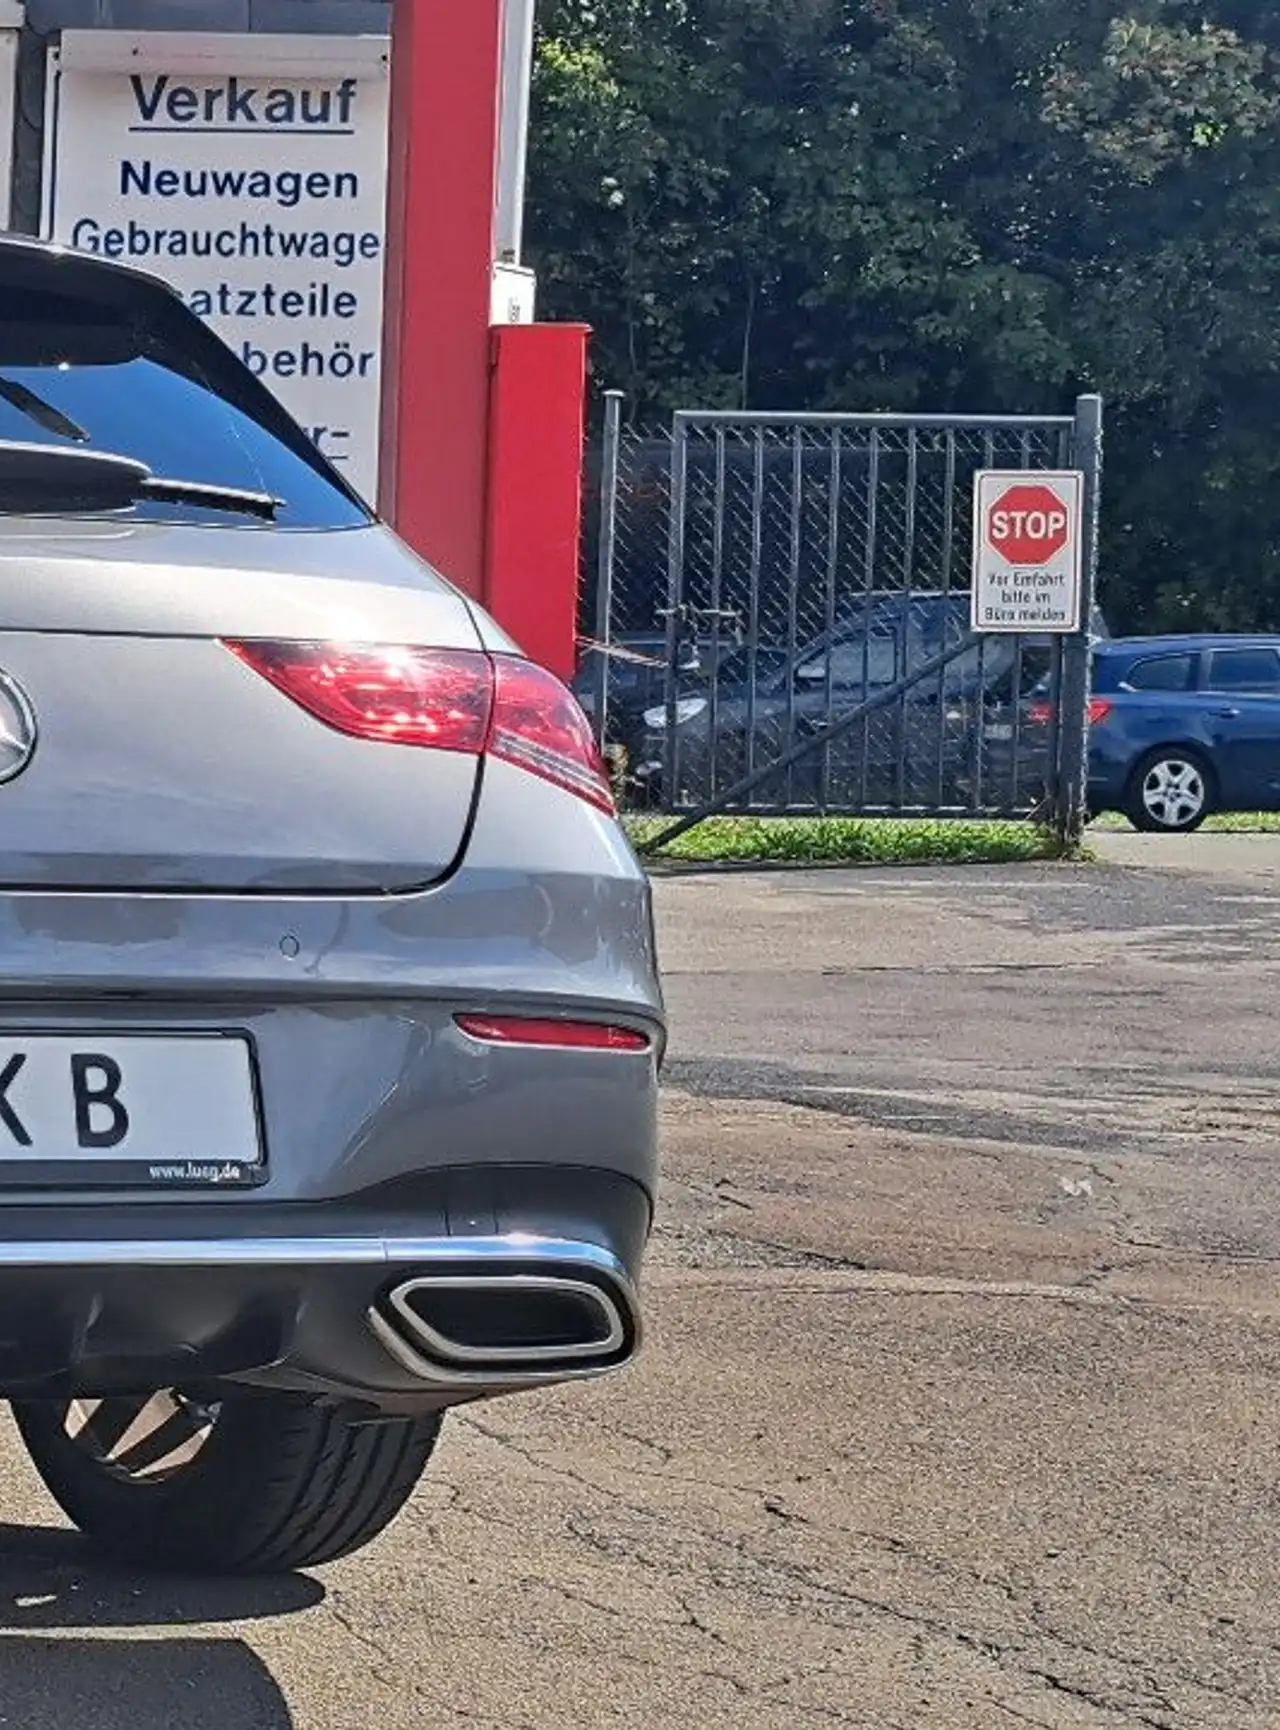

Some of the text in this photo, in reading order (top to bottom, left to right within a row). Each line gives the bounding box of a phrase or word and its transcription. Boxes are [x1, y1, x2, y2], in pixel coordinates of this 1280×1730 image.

[129, 75, 358, 123] Verkauf
[120, 160, 358, 207] Neuwagen
[72, 218, 380, 267] Gebrauchtwage
[178, 283, 358, 318] atzteile
[991, 511, 1065, 539] STOP
[988, 571, 1065, 587] Vor Einfahrt
[1001, 589, 1051, 604] bitte im
[985, 606, 1066, 620] Büro melden
[149, 1161, 240, 1182] www.lueg.de
